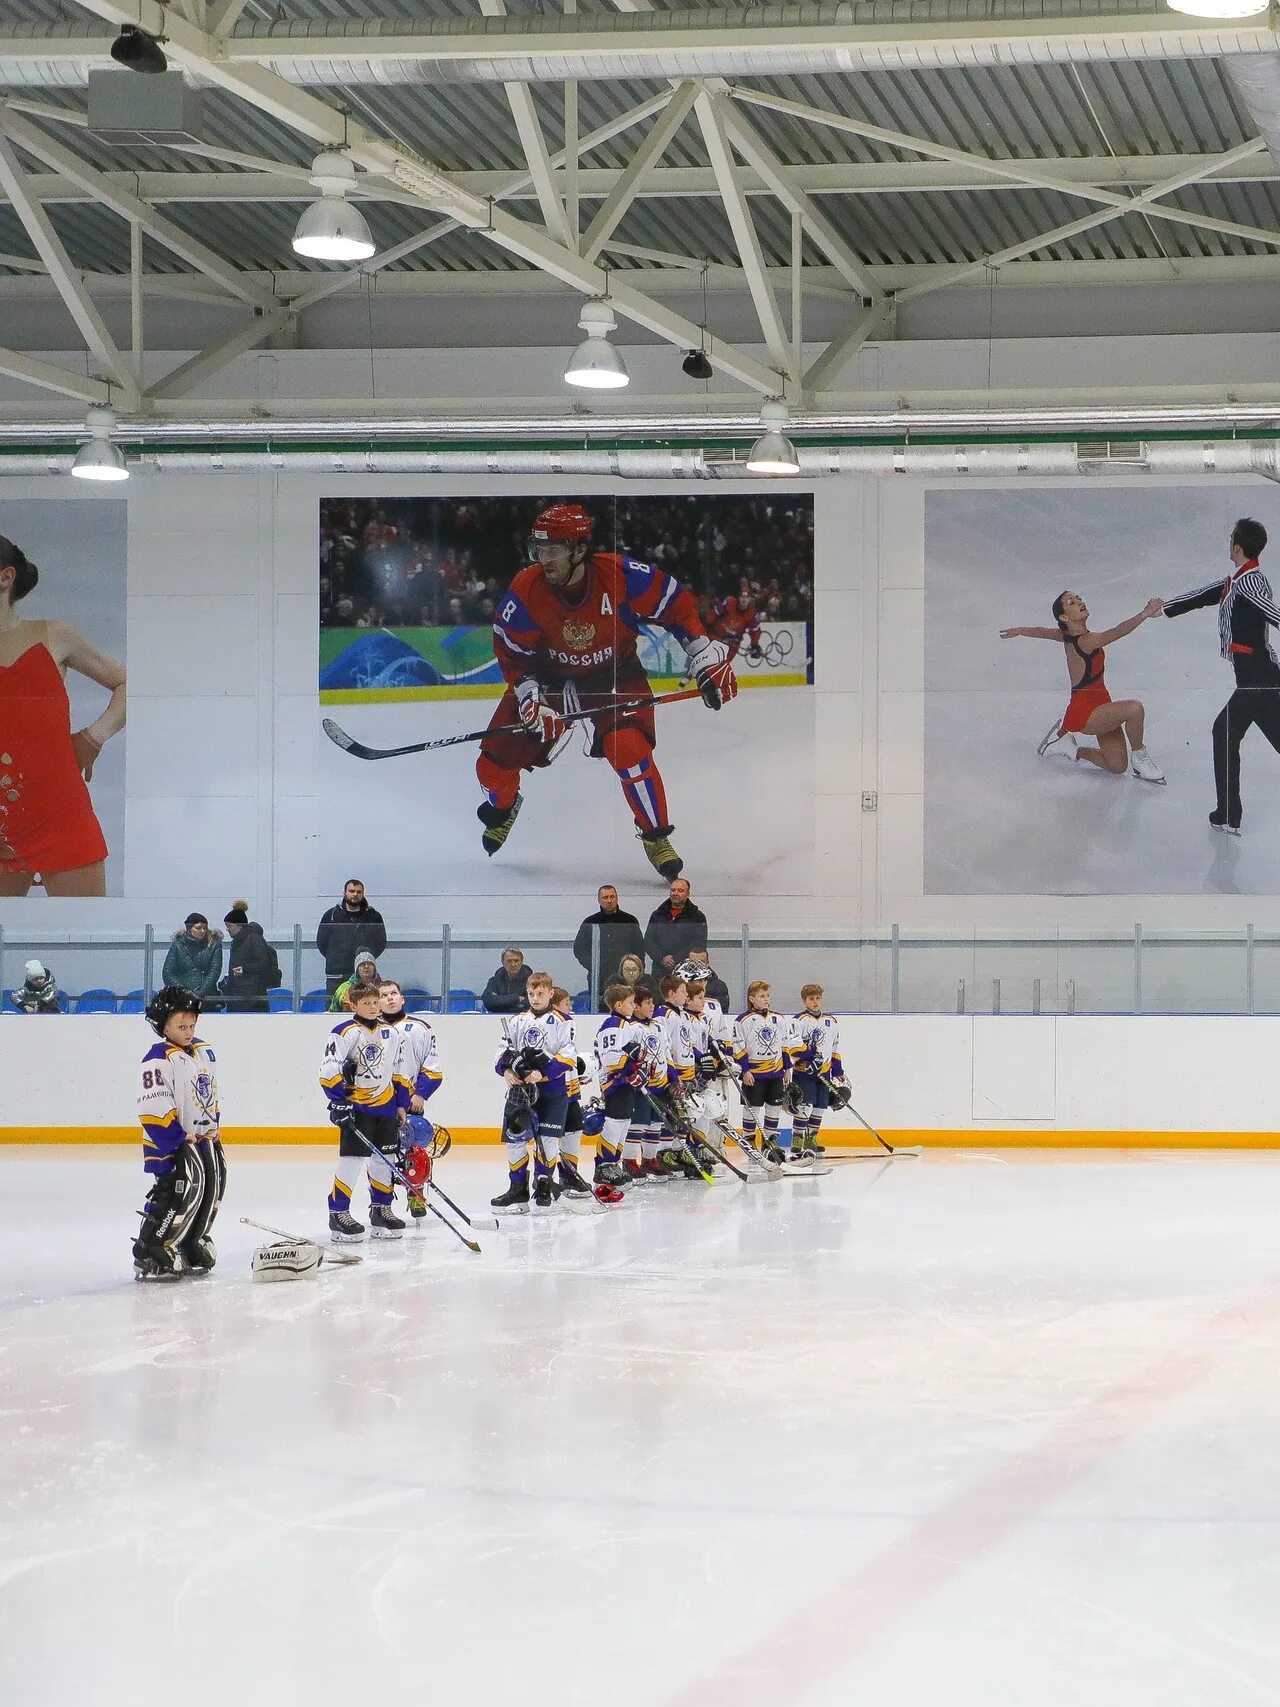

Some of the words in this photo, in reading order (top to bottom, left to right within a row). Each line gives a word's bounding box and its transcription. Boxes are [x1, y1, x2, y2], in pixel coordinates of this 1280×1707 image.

[629, 561, 650, 574] 8
[502, 600, 518, 622] 8
[601, 593, 613, 615] A
[549, 646, 612, 667] РОССИЯ
[603, 1034, 616, 1048] 85
[143, 1068, 164, 1089] 88
[155, 1208, 177, 1238] Reebok
[260, 1251, 297, 1260] VAUGHN
